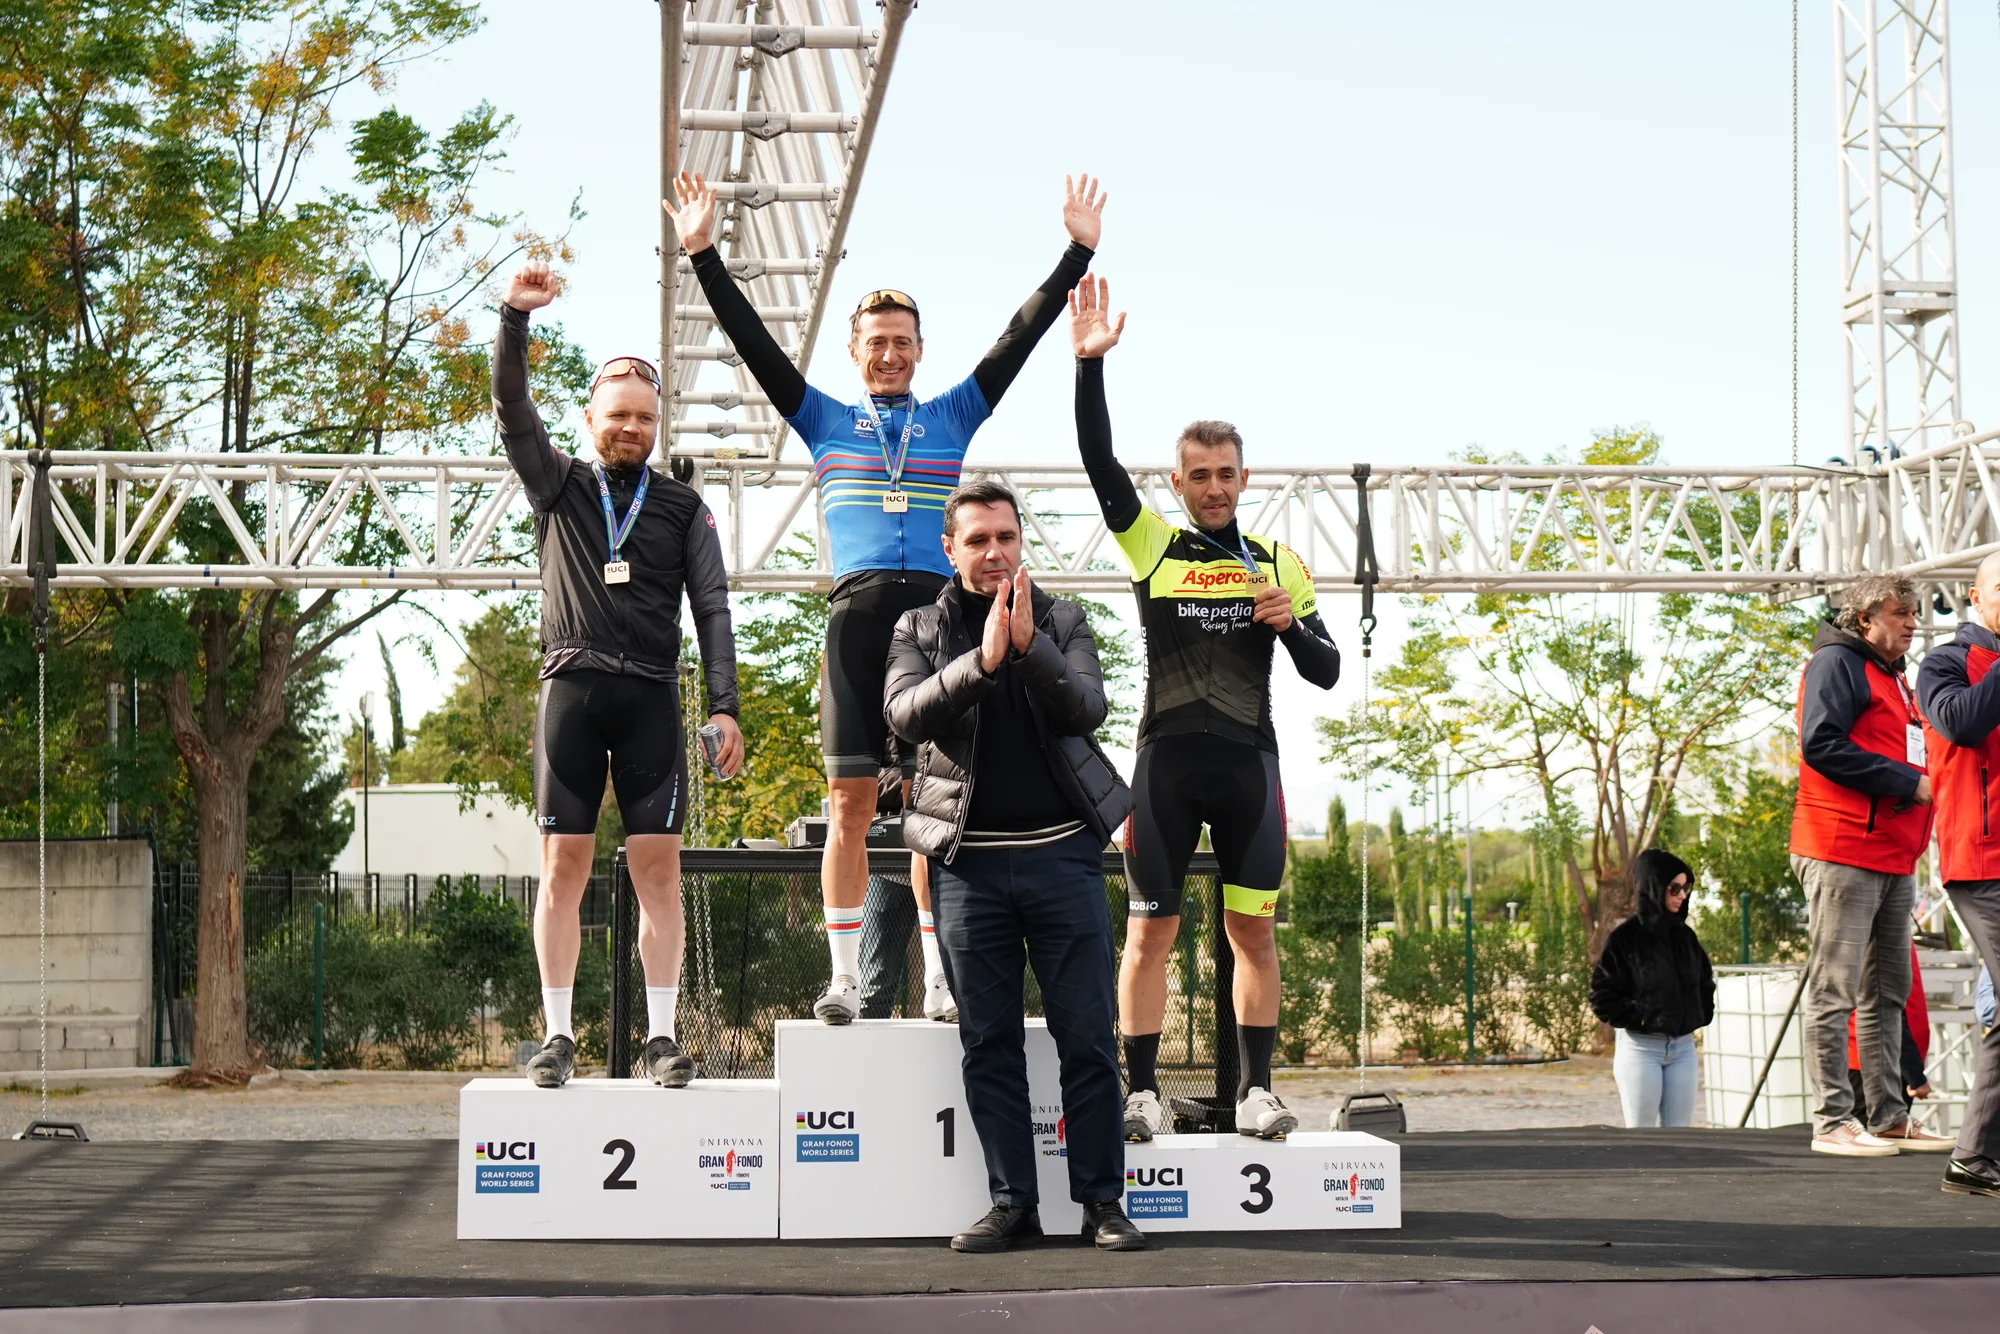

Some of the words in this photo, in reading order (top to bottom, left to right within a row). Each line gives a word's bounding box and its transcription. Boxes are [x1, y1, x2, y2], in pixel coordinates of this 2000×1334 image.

[610, 565, 627, 573] UCI
[1251, 576, 1268, 584] UCI
[1178, 602, 1209, 617] bike
[1210, 602, 1252, 621] pedia
[1200, 619, 1228, 634] Racing
[1230, 617, 1251, 631] Team
[807, 1111, 855, 1130] UCI
[936, 1107, 955, 1157] 1
[1031, 1122, 1056, 1136] GRAN
[707, 1138, 763, 1146] NIRVANA
[487, 1141, 535, 1161] UCI
[602, 1139, 637, 1190] 2
[698, 1155, 725, 1169] GRAN
[737, 1154, 763, 1168] FONDO
[1331, 1161, 1385, 1170] NIRVANA
[481, 1171, 505, 1179] GRAN
[506, 1171, 534, 1179] FONDO
[1136, 1167, 1183, 1187] UCI
[1239, 1163, 1274, 1214] 3
[1323, 1178, 1348, 1192] GRAN
[1360, 1177, 1385, 1191] FONDO
[1155, 1196, 1183, 1204] FONDO
